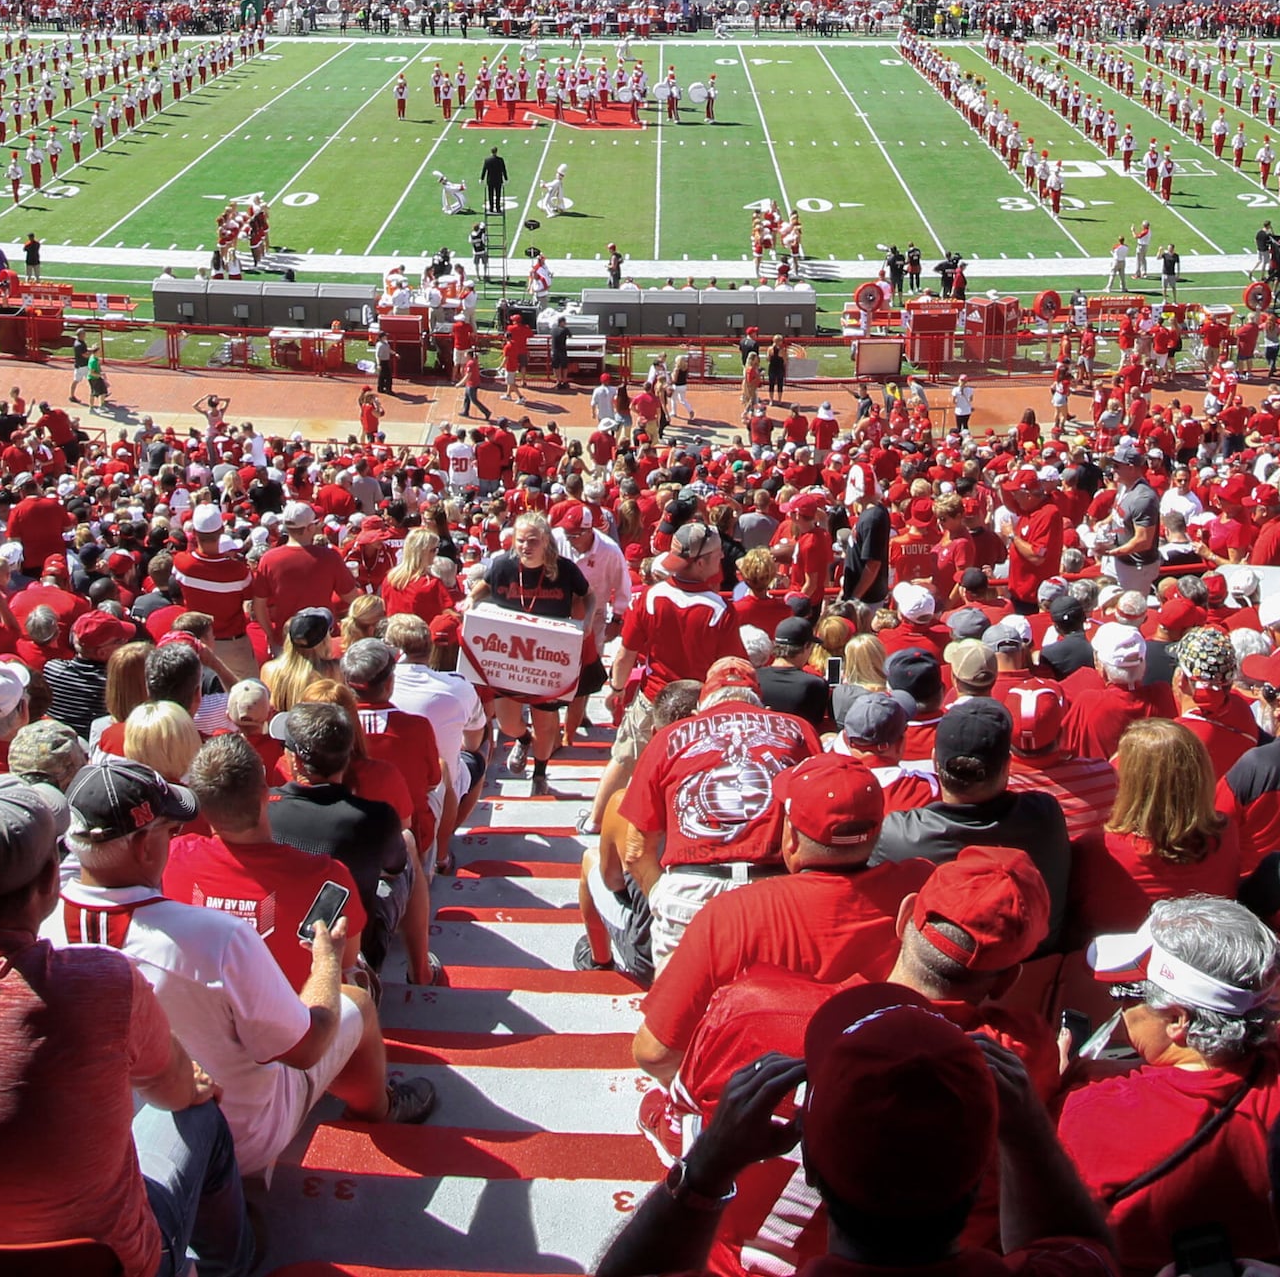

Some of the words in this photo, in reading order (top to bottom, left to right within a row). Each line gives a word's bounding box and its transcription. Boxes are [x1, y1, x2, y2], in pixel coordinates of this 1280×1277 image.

[460, 98, 650, 130] N
[229, 190, 321, 208] 40
[742, 197, 835, 214] 40
[451, 457, 469, 473] 20
[900, 543, 933, 556] TOOVE
[480, 658, 520, 673] OFFICIAL
[521, 665, 548, 677] PIZZA
[549, 671, 563, 680] OF
[508, 670, 562, 689] HUSKERS
[666, 711, 805, 760] MARINES
[130, 800, 155, 828] N
[859, 833, 868, 843] N
[676, 843, 718, 862] FIRST
[206, 895, 224, 909] DAY
[238, 899, 257, 912] DAY
[303, 1176, 357, 1201] 33
